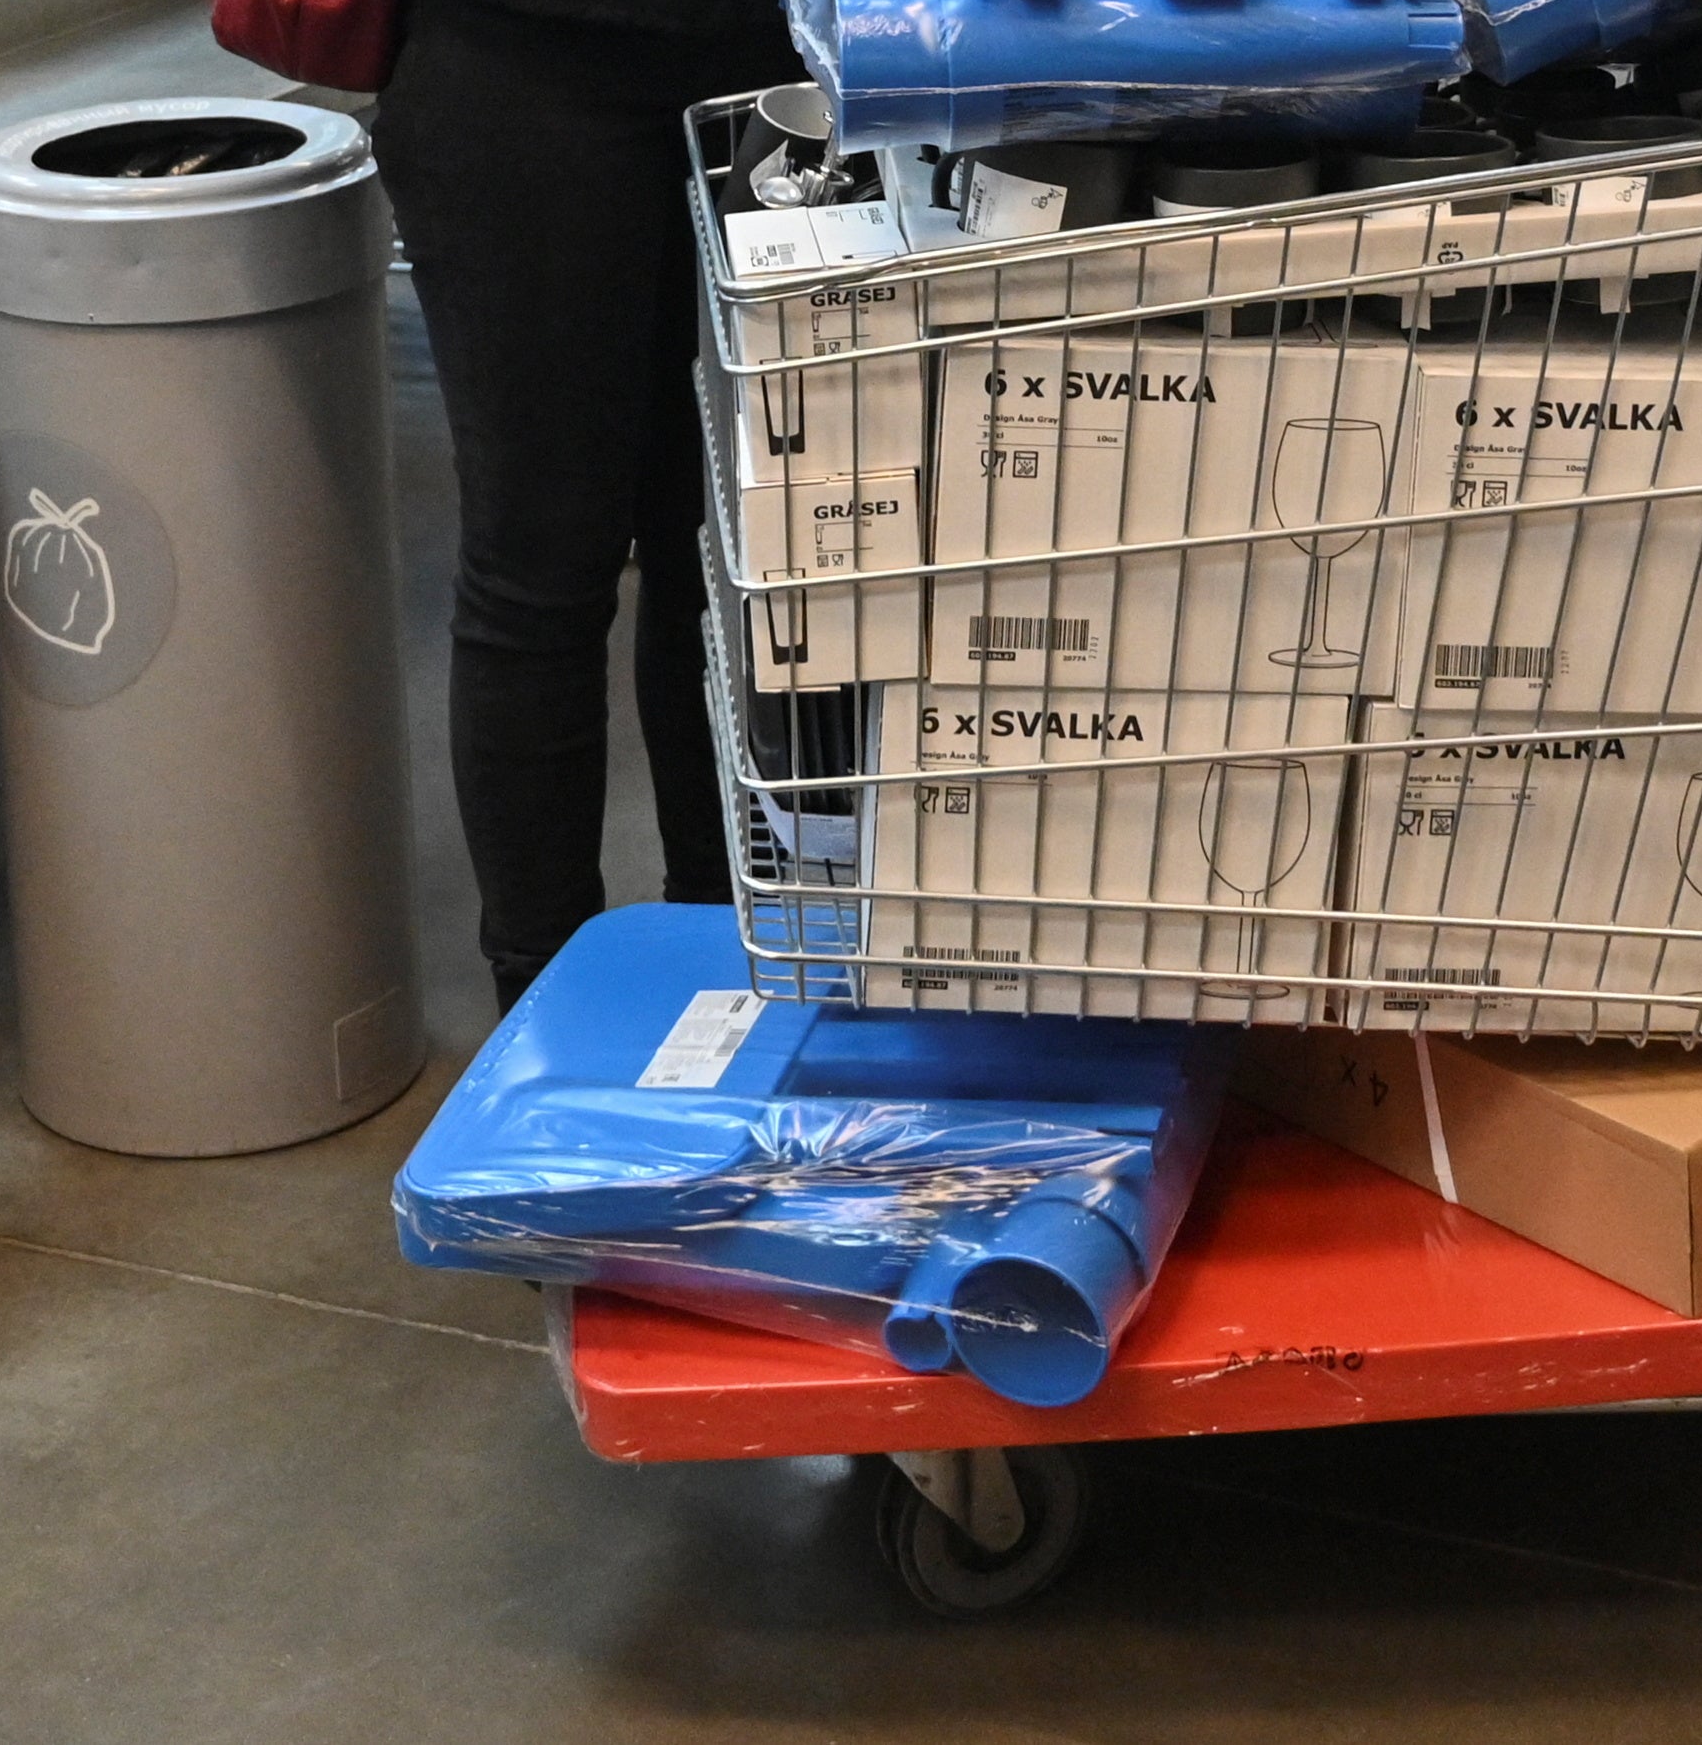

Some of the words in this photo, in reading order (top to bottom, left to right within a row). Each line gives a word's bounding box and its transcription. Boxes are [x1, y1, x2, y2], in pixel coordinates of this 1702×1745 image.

[136, 98, 211, 115] мусор
[984, 369, 1008, 399] 6
[1021, 376, 1046, 399] x
[1062, 371, 1218, 404] SVALKA
[983, 414, 1014, 424] Dsign
[1455, 400, 1478, 427] 6
[1492, 406, 1516, 428] x
[1534, 402, 1684, 432] SVALKA
[1454, 444, 1485, 454] Dsign
[1507, 445, 1528, 454] Gra
[920, 707, 940, 734] 6
[954, 714, 977, 735] x
[991, 710, 1144, 742] SVALKA
[918, 752, 947, 761] esign
[969, 753, 990, 762] Gy
[1406, 775, 1433, 785] esign
